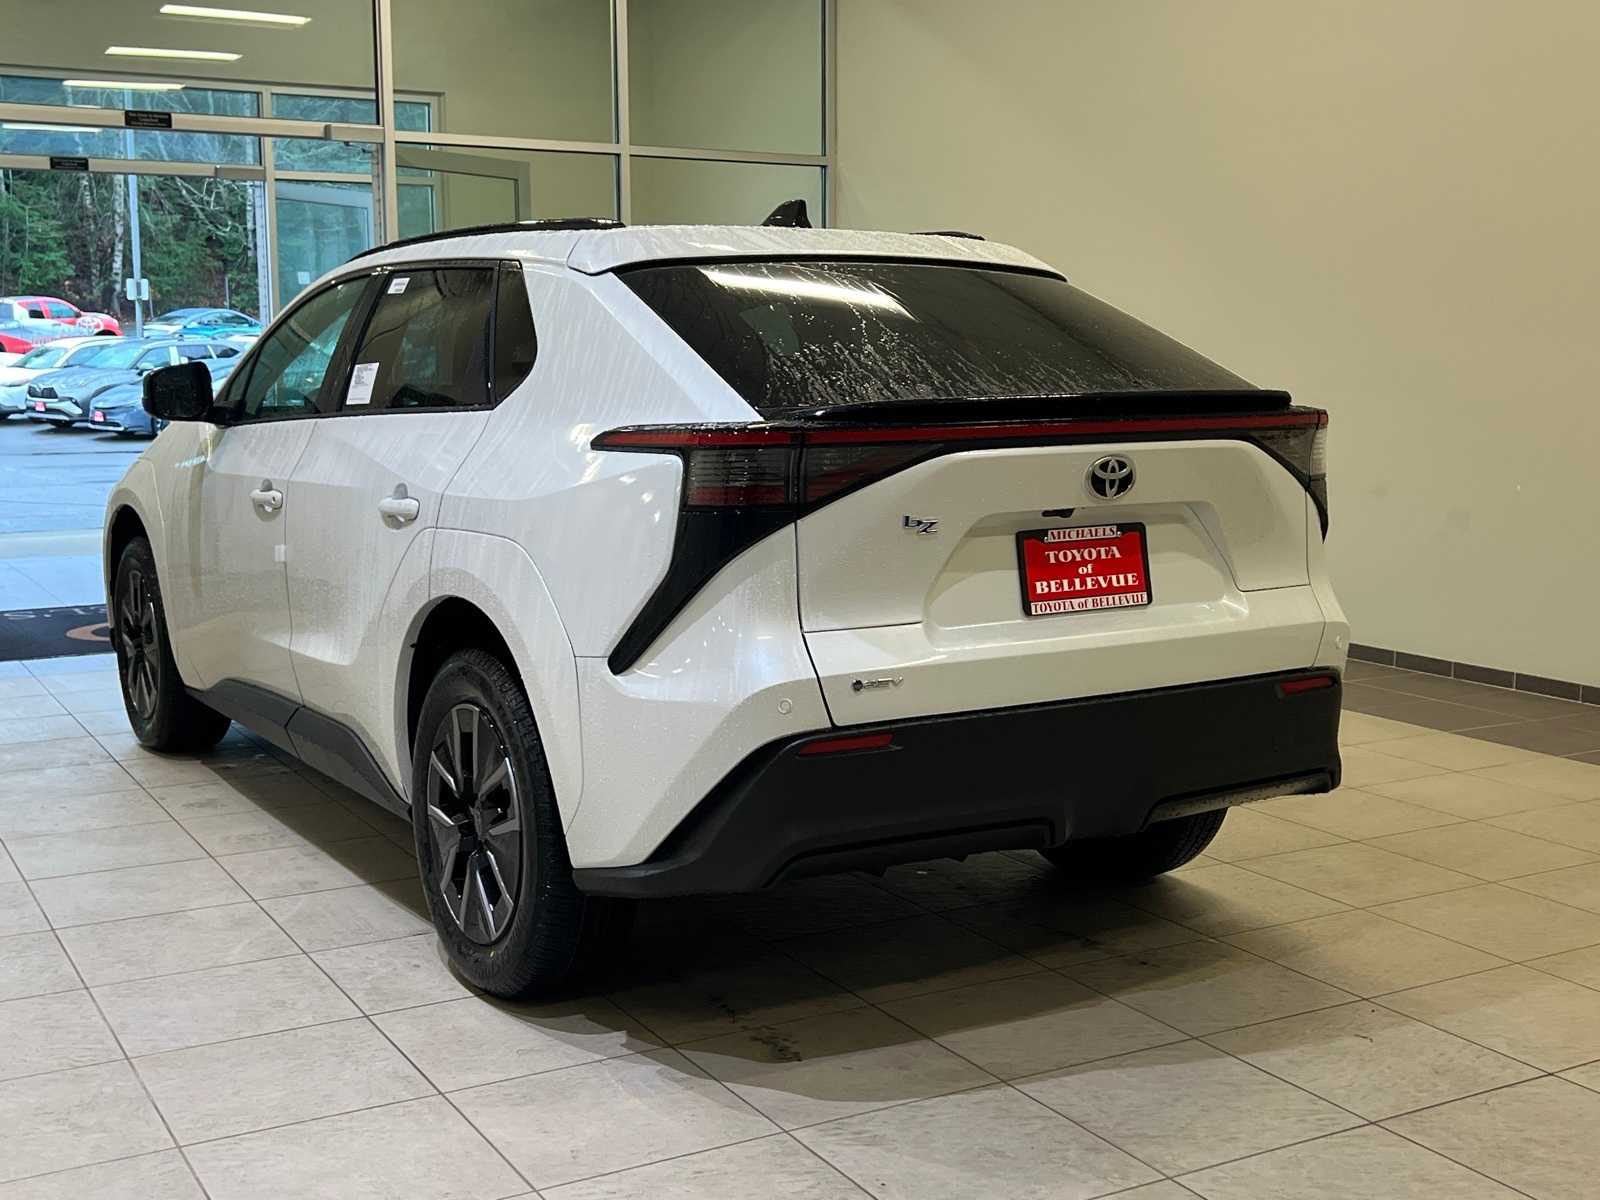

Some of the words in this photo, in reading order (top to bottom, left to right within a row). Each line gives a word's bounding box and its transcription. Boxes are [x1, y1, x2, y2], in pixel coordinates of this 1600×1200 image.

[1050, 527, 1115, 541] MICHAELS
[1045, 547, 1121, 563] TOYOTA
[1078, 564, 1094, 574] of
[1035, 574, 1139, 594] BELLEVUE
[1032, 601, 1075, 614] TOYOTA
[1078, 599, 1089, 609] of
[1092, 594, 1146, 608] BELLEVUE
